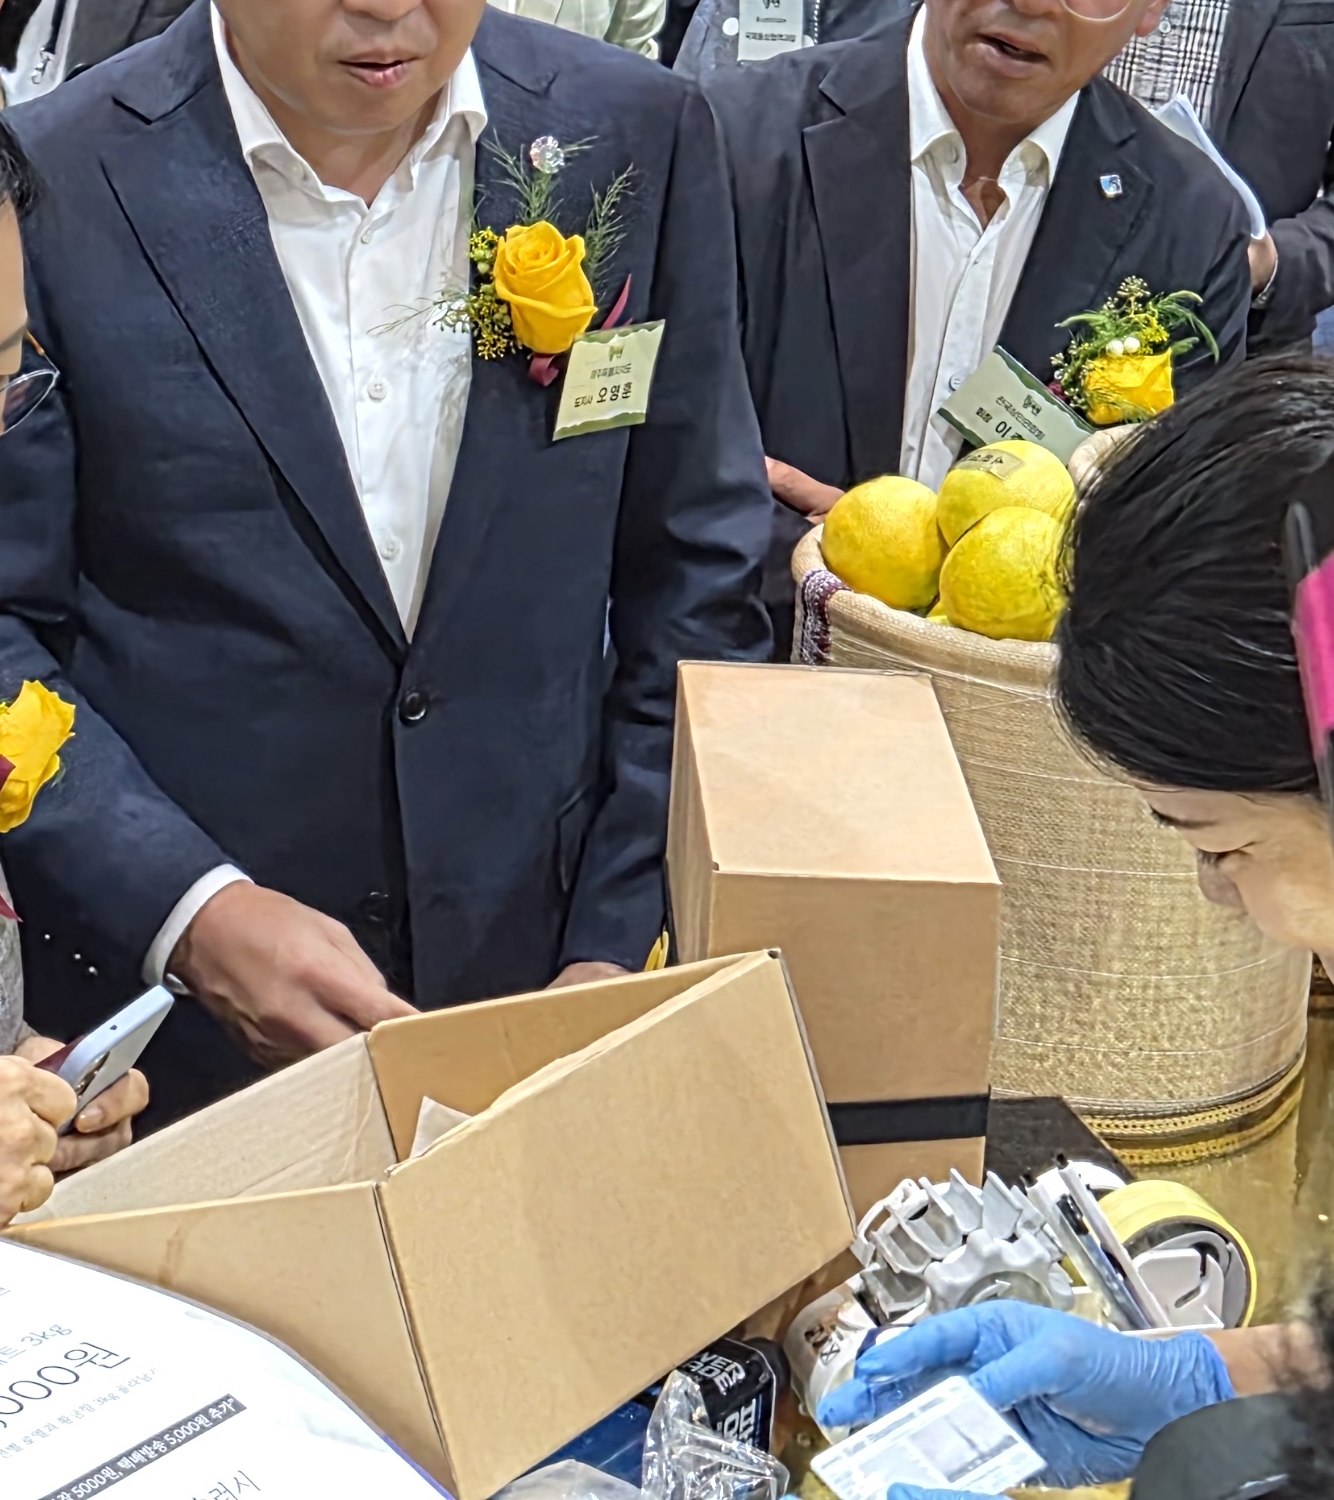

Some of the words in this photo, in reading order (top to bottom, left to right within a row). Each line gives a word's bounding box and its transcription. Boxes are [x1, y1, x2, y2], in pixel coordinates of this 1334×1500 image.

[596, 381, 633, 404] 오영훈
[20, 1324, 73, 1347] 3kg
[71, 1465, 124, 1499] 5000원,
[116, 1439, 168, 1471] 택배발송
[163, 1413, 213, 1447] 5,000원
